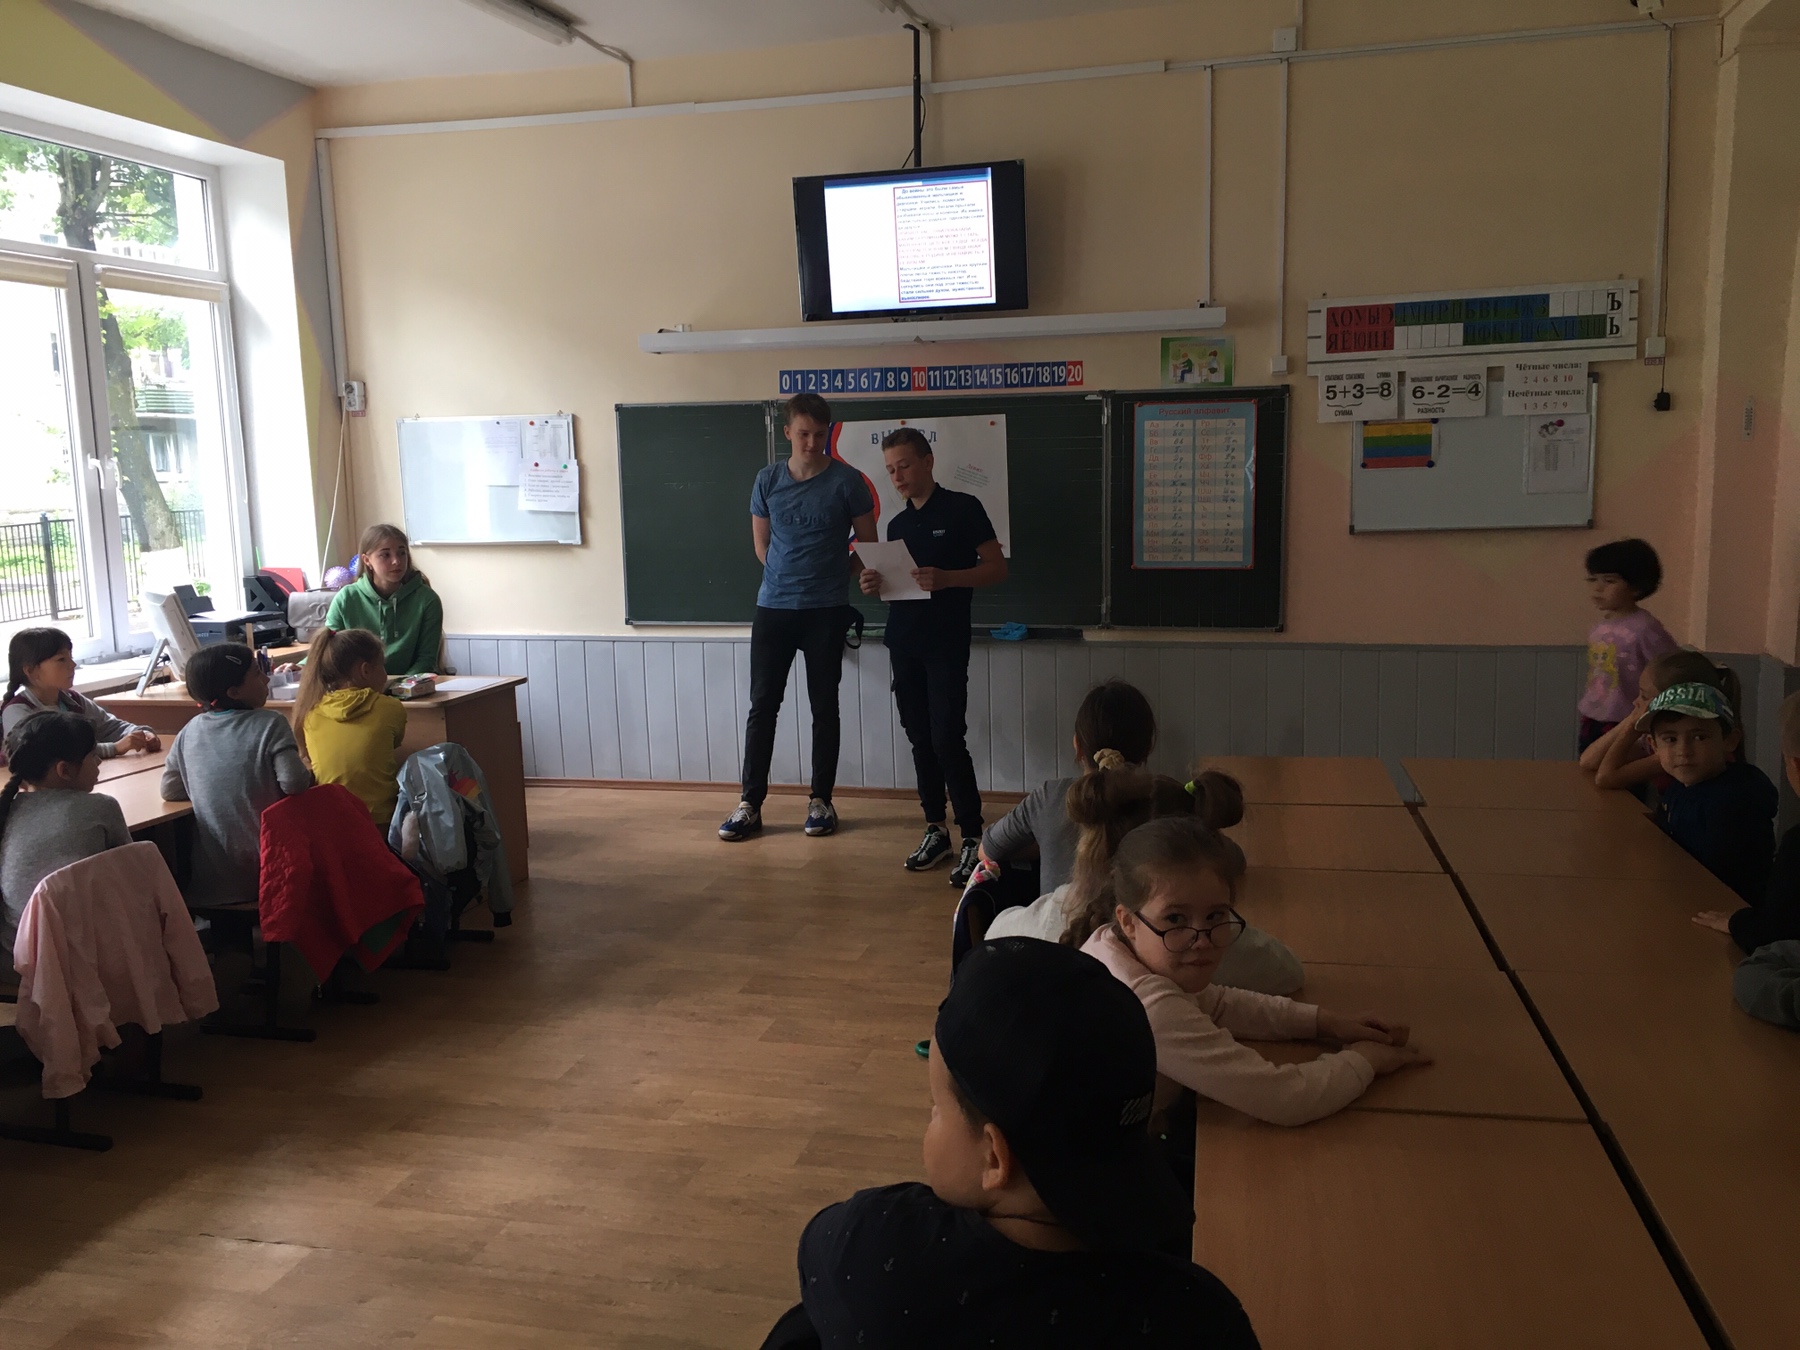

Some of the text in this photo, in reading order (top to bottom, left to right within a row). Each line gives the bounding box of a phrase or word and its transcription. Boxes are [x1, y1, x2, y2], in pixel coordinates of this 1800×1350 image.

[1516, 363, 1550, 371] Чётные
[782, 365, 1082, 390] 0 1 2 3 4 5 6 7 8 9 10 11 12 13 14 15 16 17 18 19 20
[1523, 376, 1529, 384] 2
[1553, 375, 1559, 383] 8
[1508, 390, 1553, 398] Нечётные
[1159, 407, 1230, 417] Русский алфавит
[1334, 409, 1353, 417] СУММА
